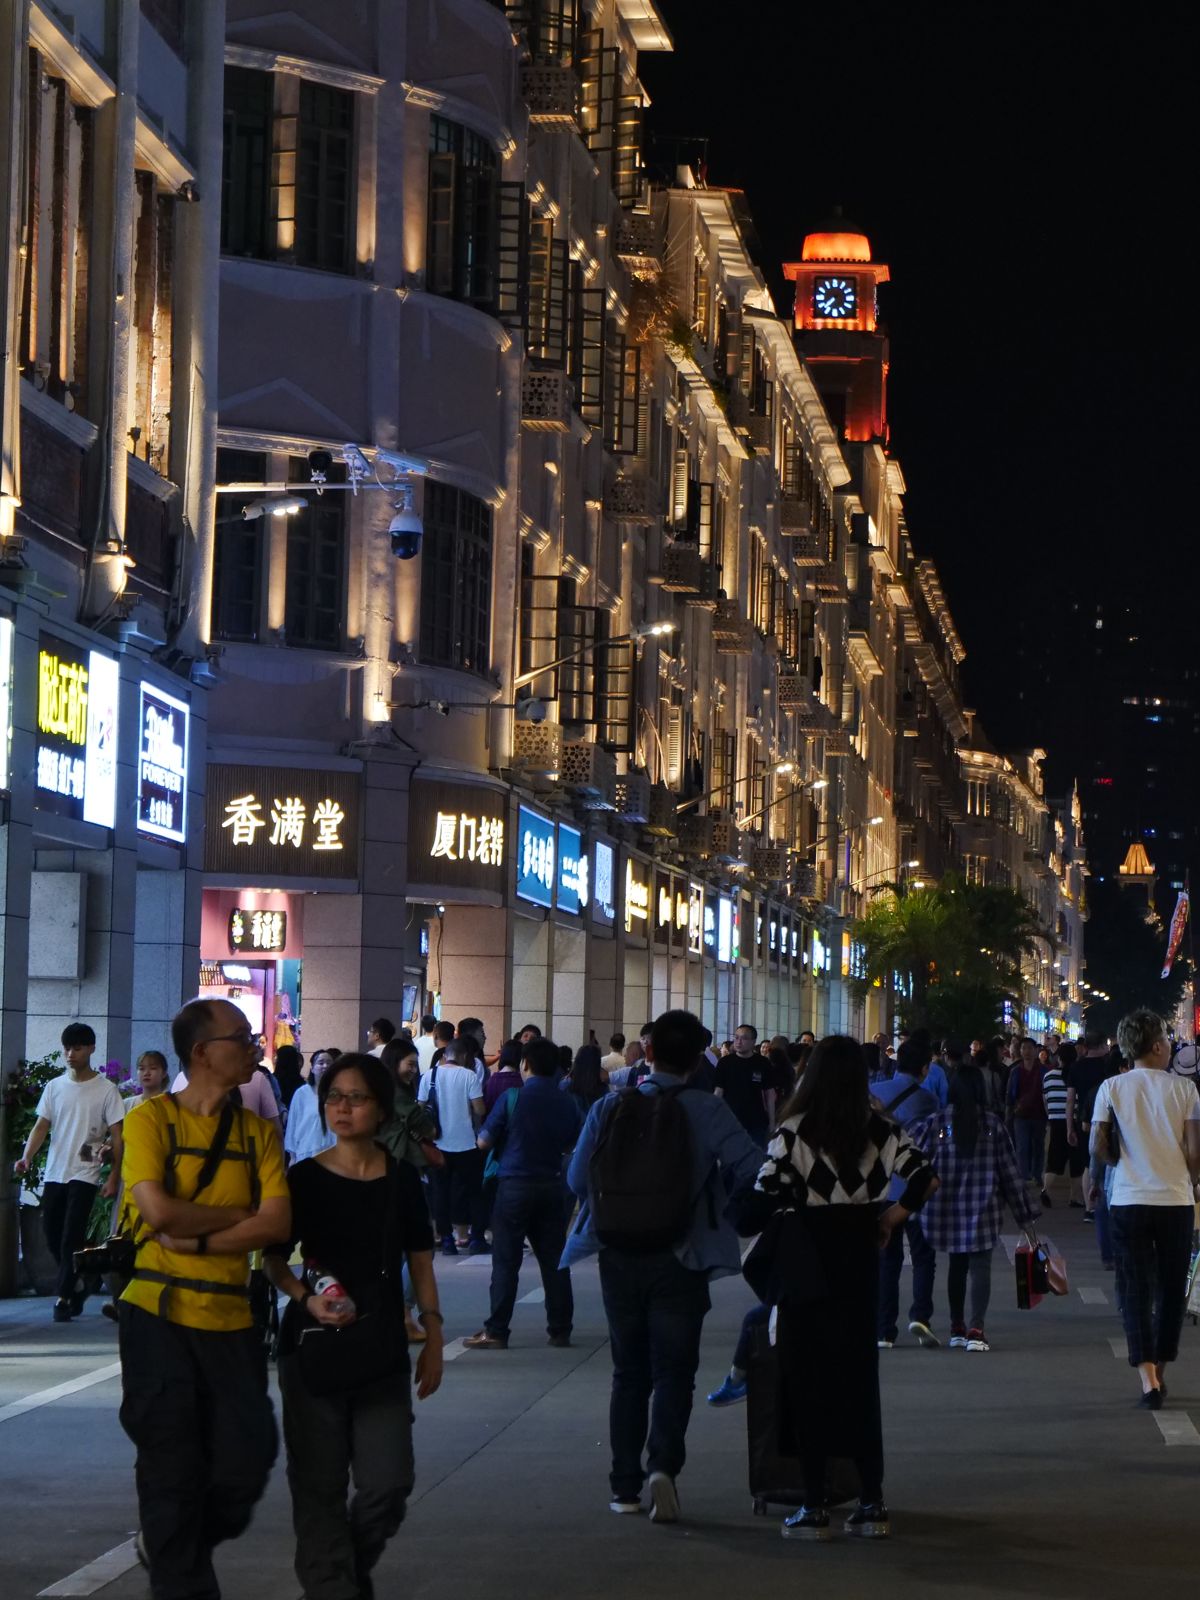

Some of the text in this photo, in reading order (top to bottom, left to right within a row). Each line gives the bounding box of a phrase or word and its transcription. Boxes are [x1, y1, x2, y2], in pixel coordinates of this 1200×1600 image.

[221, 794, 345, 851] 香满堂
[430, 811, 504, 867] 厦门老字号
